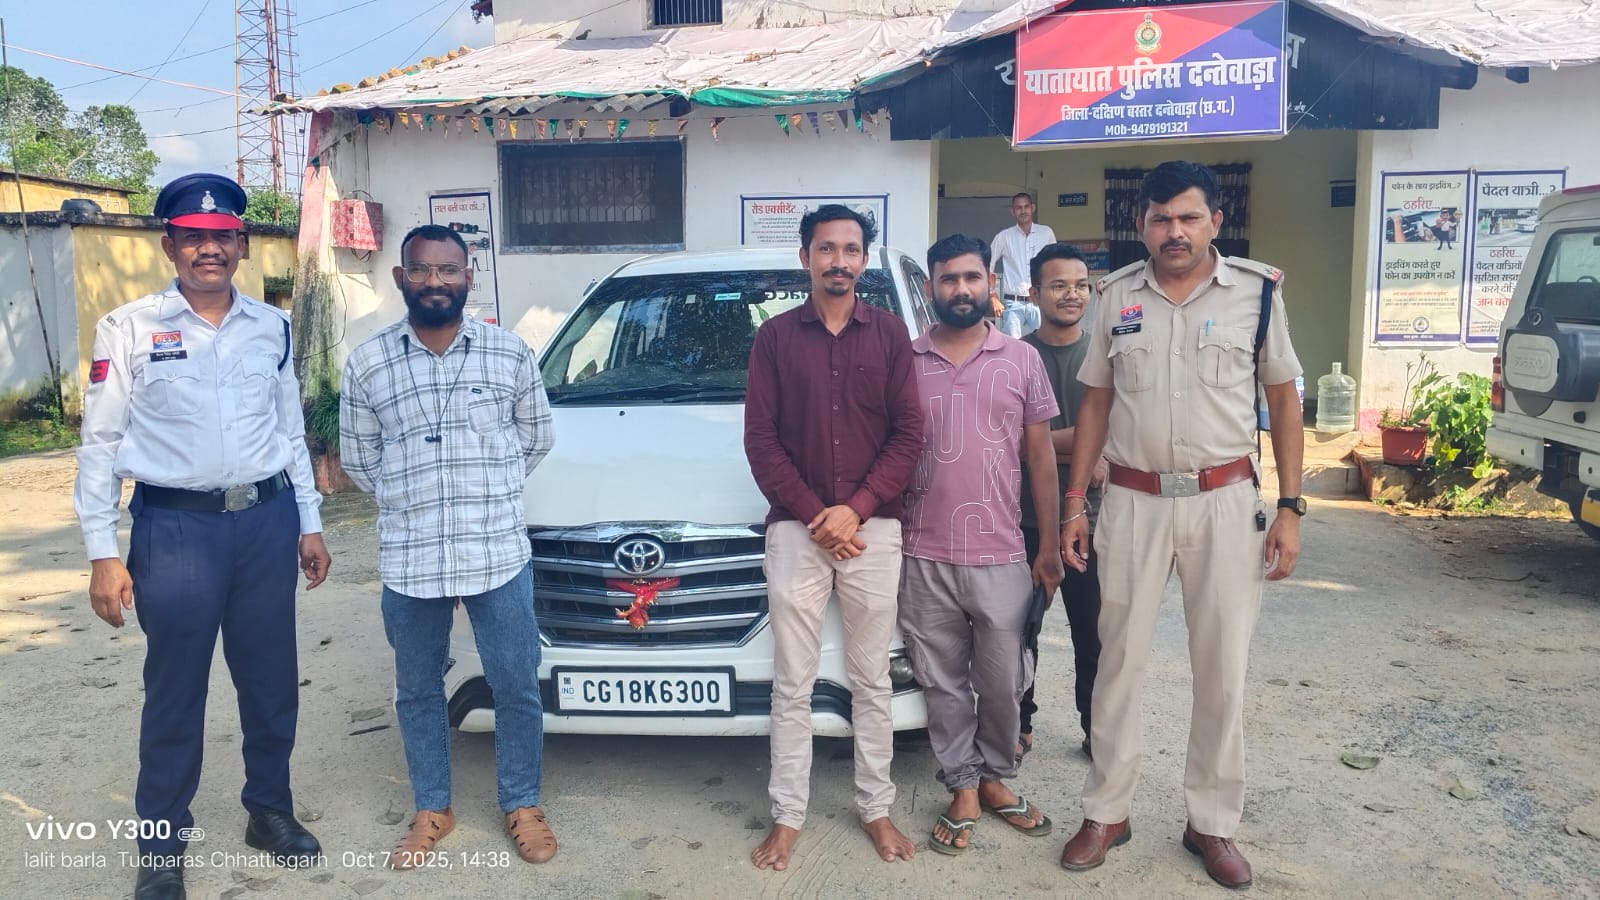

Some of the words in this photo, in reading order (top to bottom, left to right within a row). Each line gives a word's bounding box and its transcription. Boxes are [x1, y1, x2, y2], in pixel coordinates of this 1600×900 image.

[1023, 66, 1113, 95] यातायात
[1117, 57, 1184, 100] पुलिस
[1127, 105, 1154, 118] बस्तर
[1482, 182, 1509, 196] पैदल
[752, 202, 764, 214] रोड
[561, 686, 575, 695] IND
[582, 679, 720, 704] CG18K6300
